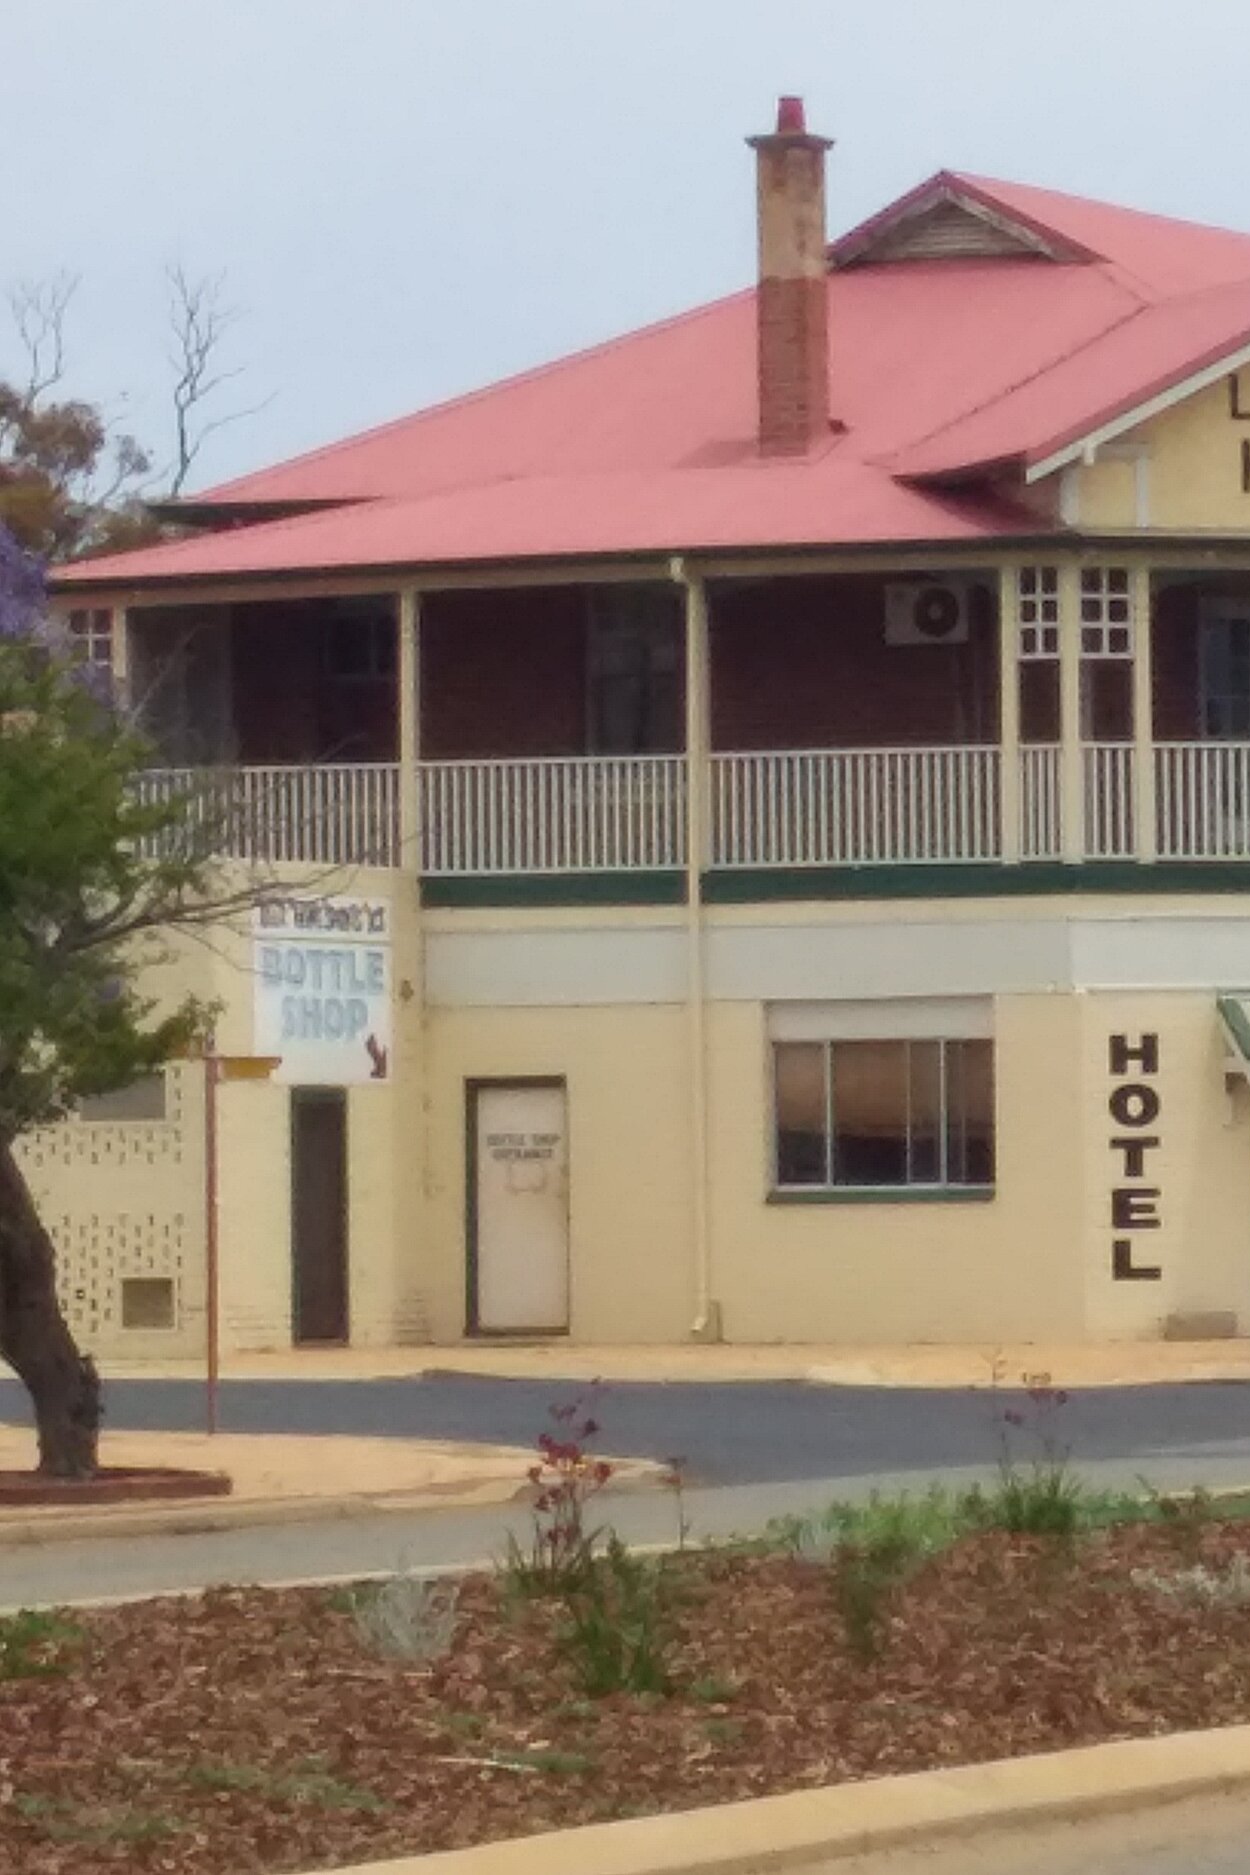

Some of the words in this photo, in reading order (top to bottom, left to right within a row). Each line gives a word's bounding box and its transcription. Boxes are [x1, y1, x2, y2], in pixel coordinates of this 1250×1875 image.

[261, 947, 384, 993] BOTTLE
[281, 996, 368, 1041] SHOP
[1108, 1033, 1162, 1281] HOTEL
